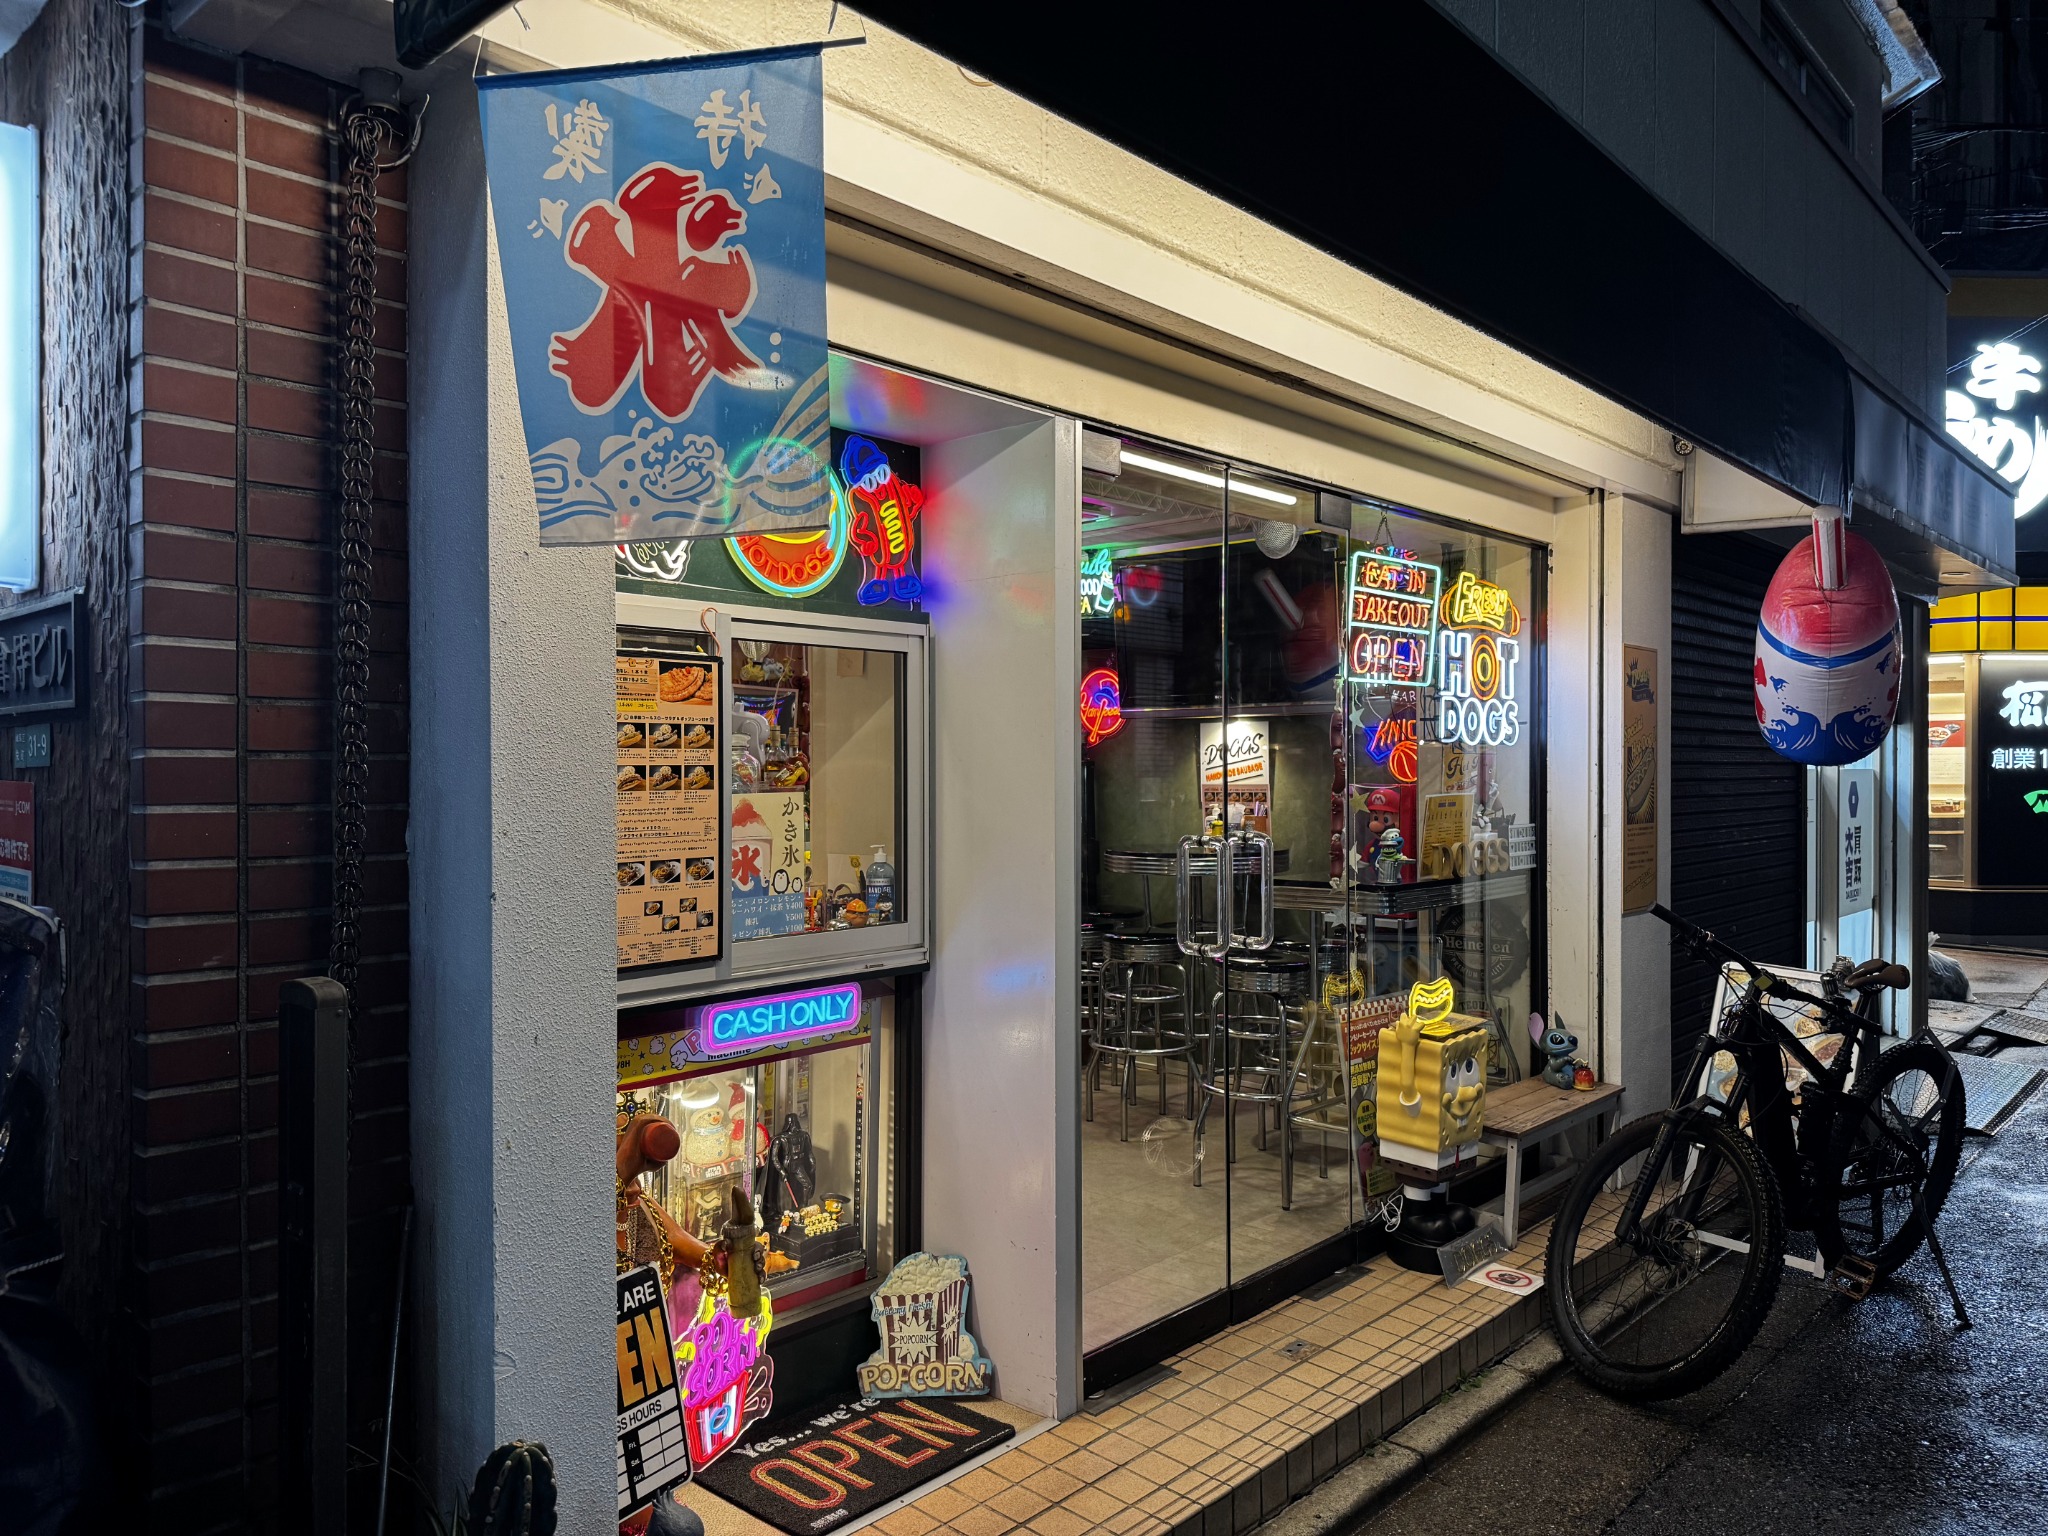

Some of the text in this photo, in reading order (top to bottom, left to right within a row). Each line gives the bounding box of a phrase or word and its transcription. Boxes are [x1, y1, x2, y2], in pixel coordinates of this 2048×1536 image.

[736, 535, 835, 585] HOT DOGS
[1365, 560, 1427, 595] EAT IN
[1354, 593, 1431, 629] TAKEOUT
[1454, 571, 1508, 624] FRESH
[1353, 632, 1426, 678] OPEN
[1440, 630, 1519, 701] HOT
[1441, 696, 1519, 746] DOGS
[28, 734, 47, 757] 31-9
[1204, 732, 1264, 765] DOGGS
[782, 796, 802, 867] かき氷
[732, 844, 762, 887] 氷
[1431, 838, 1509, 880] DOGGS
[785, 901, 803, 911] ¥400
[868, 886, 882, 894] HAND
[785, 913, 803, 922] ¥500
[714, 992, 854, 1040] CASH ONLY
[624, 1280, 657, 1313] ARE
[899, 1334, 929, 1345] POPCORN
[860, 1361, 988, 1395] POPCORN
[629, 1399, 662, 1426] HOURS
[731, 1397, 880, 1459] Yes... we're
[749, 1398, 981, 1511] OPEN
